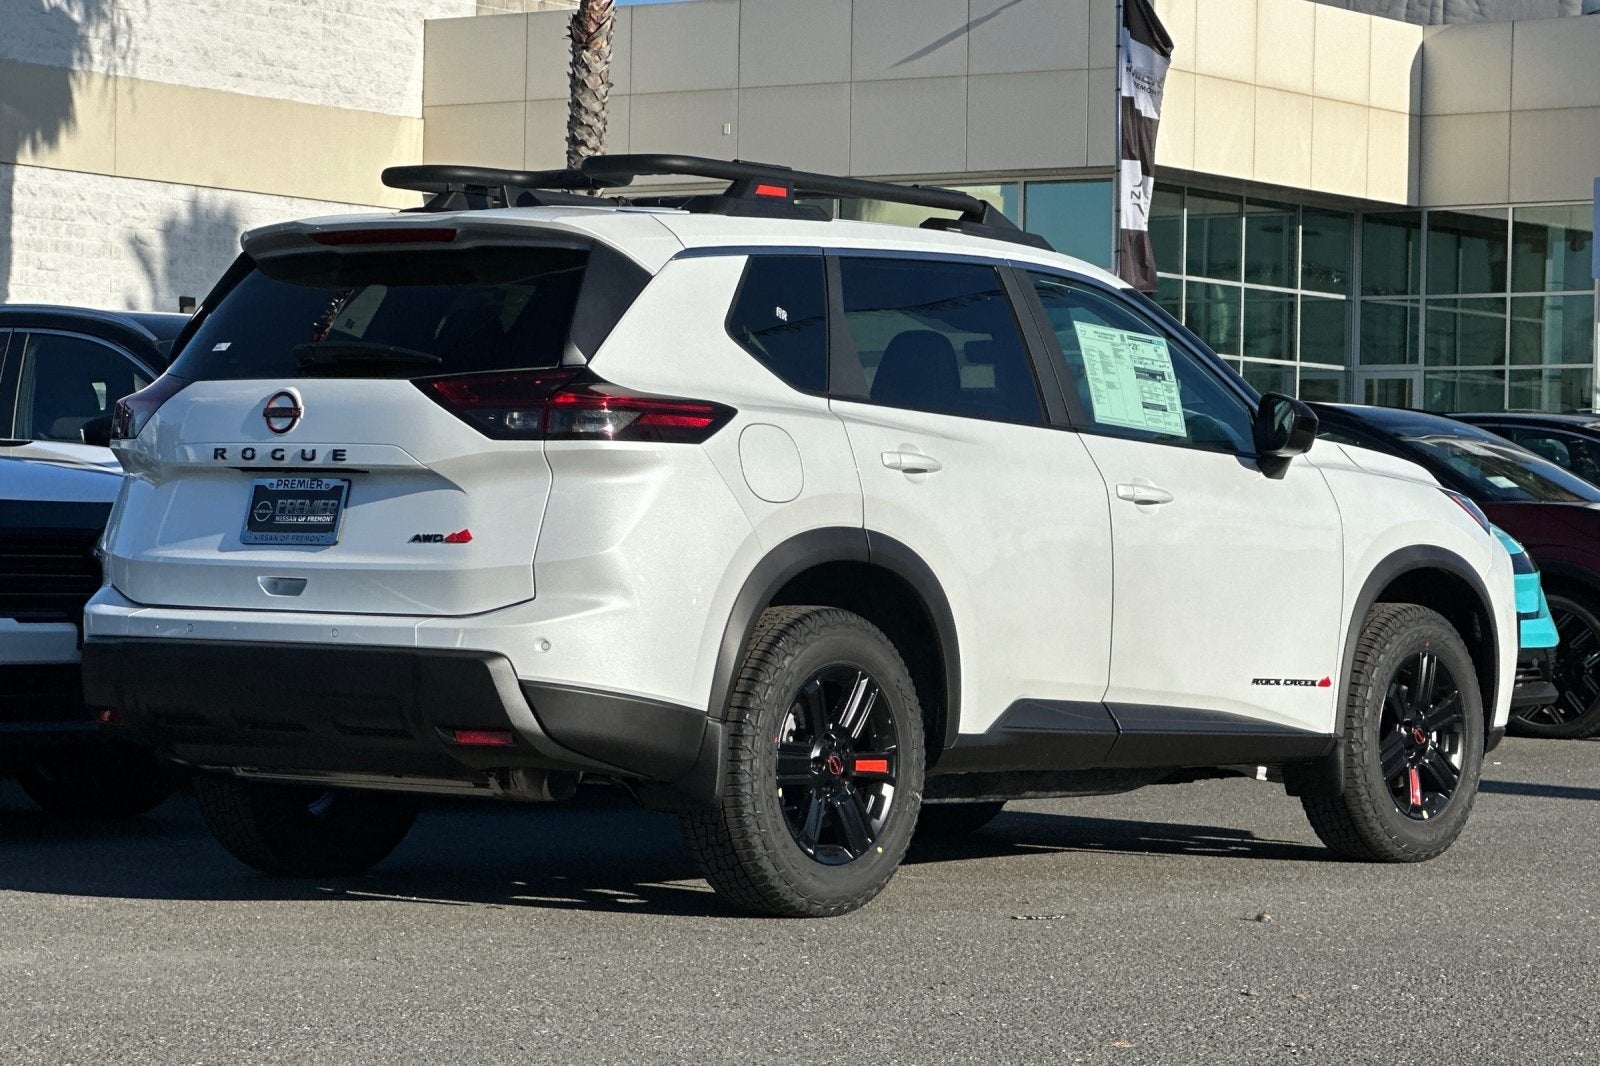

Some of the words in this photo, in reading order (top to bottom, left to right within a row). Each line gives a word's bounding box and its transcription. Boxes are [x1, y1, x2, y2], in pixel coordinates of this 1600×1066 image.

[213, 447, 347, 462] ROGUE
[276, 479, 324, 489] PREMIER
[275, 499, 338, 514] PREMIER
[407, 534, 444, 543] AWD
[1251, 678, 1282, 686] ROCK
[1283, 679, 1317, 687] CREEK
